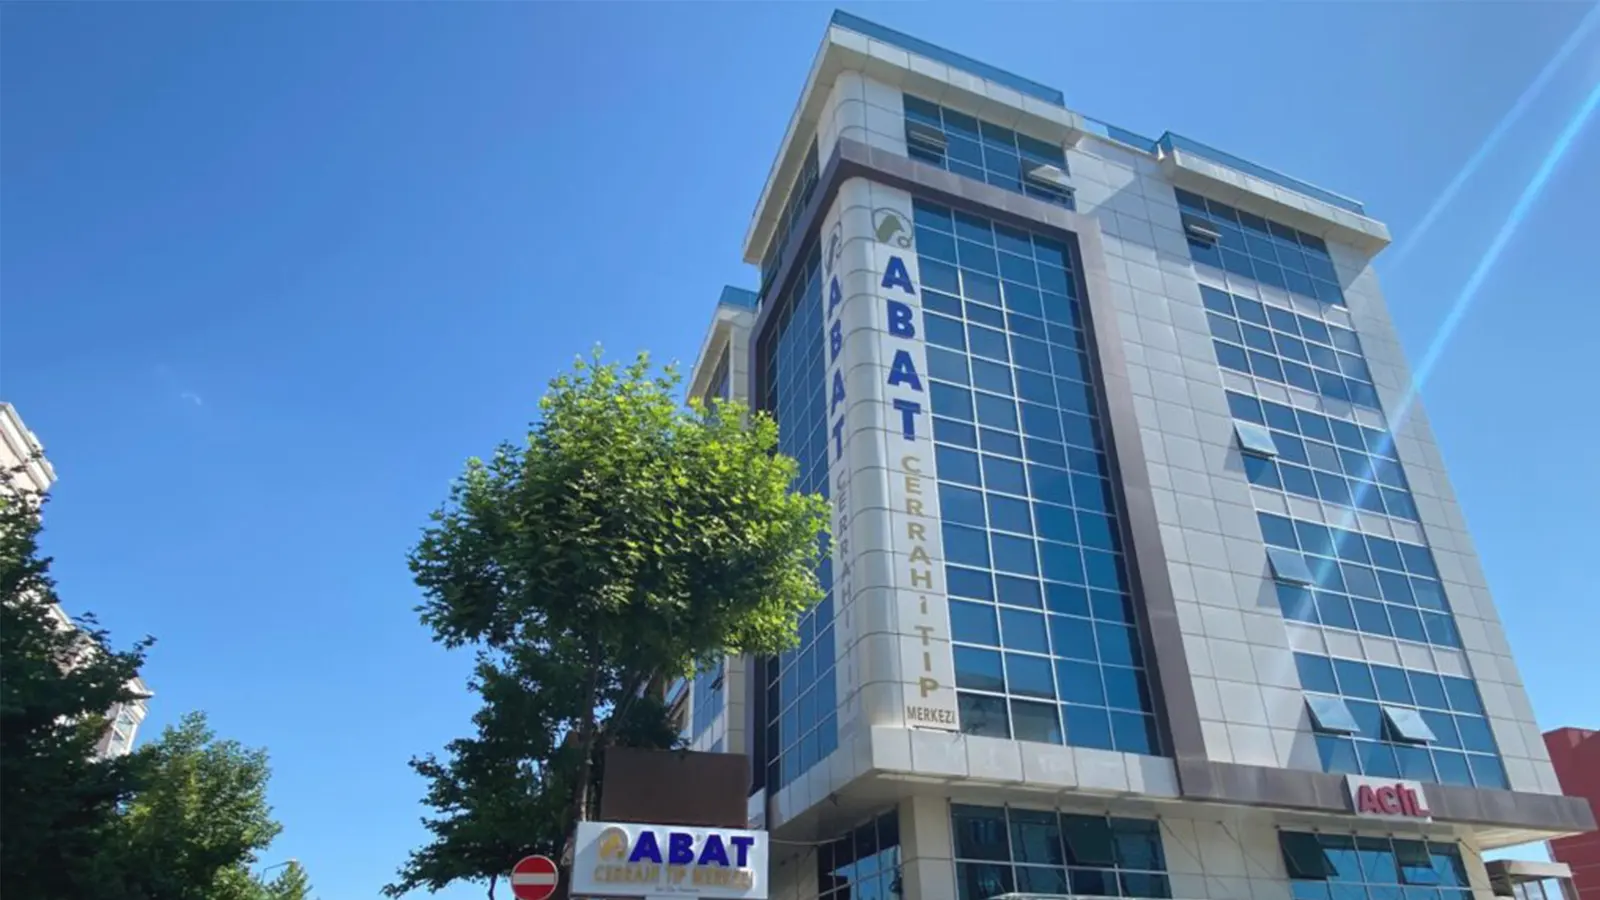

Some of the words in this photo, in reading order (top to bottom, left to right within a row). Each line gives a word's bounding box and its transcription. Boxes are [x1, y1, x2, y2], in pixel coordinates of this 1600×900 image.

[828, 274, 846, 461] ABAT
[881, 255, 923, 442] ABAT
[914, 625, 940, 698] TIP
[1358, 782, 1431, 817] ACİL
[628, 830, 754, 867] ABAT
